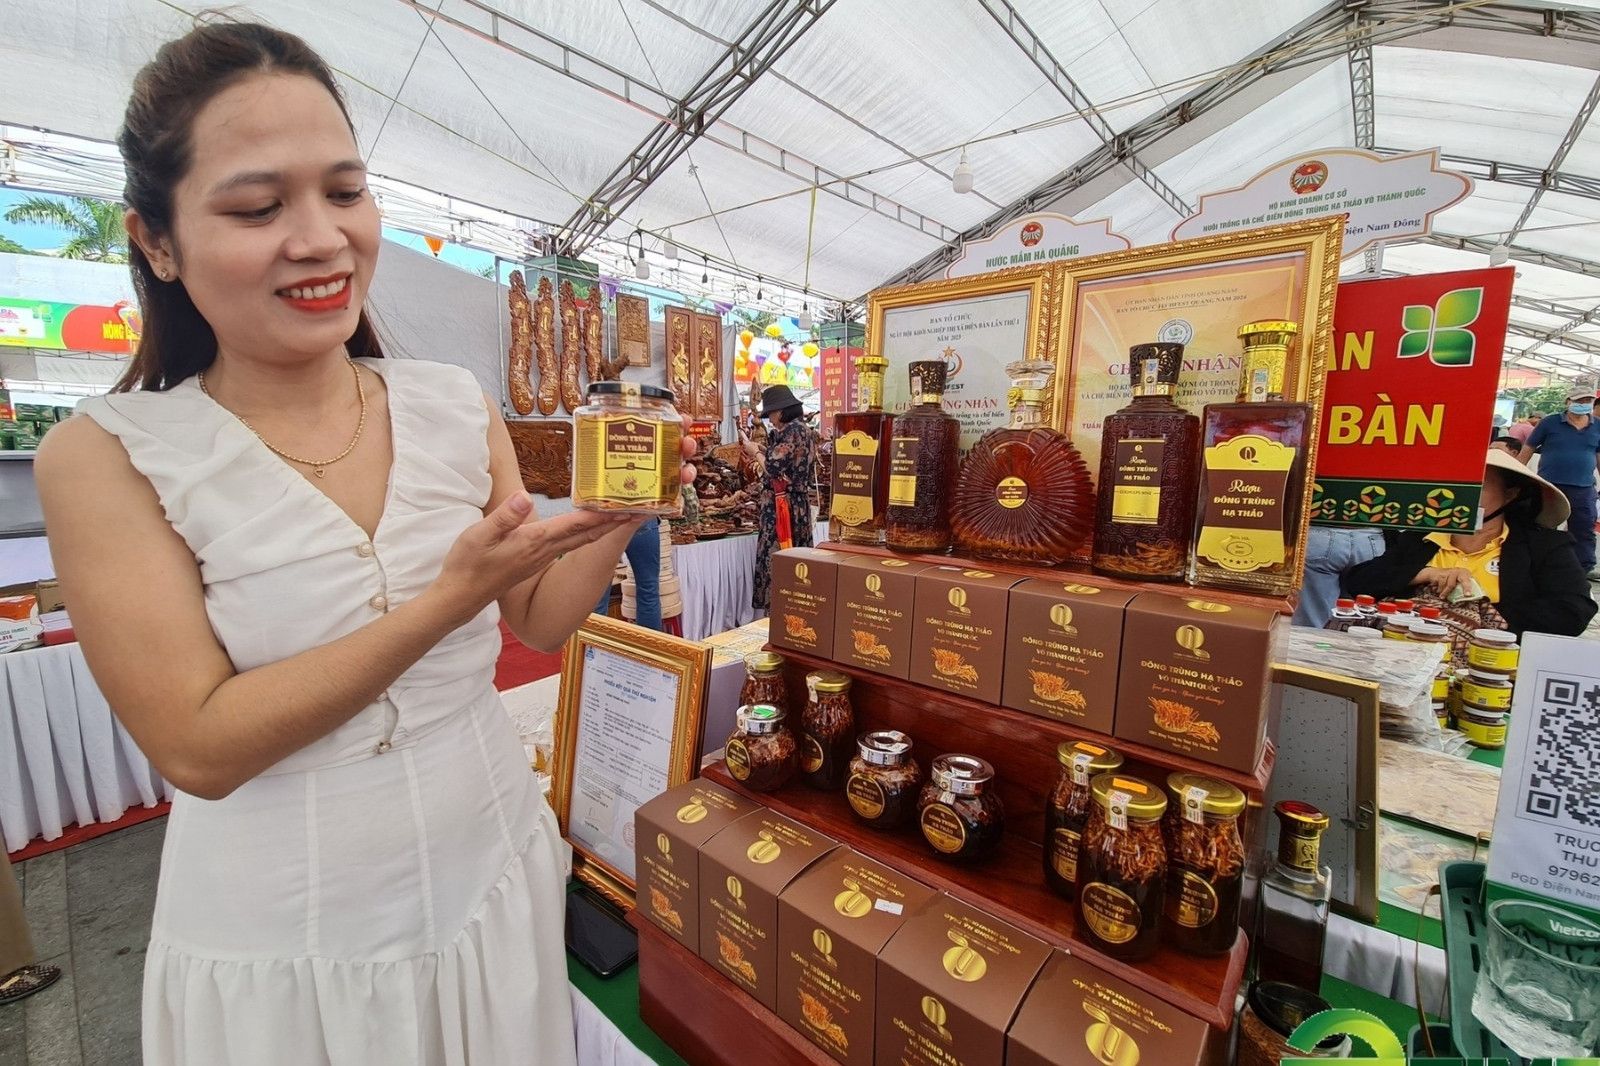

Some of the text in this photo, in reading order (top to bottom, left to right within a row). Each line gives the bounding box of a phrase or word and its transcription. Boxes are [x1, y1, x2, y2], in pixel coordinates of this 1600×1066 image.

[1203, 222, 1218, 232] NUÔI
[1220, 219, 1240, 229] TRỒNG
[1242, 217, 1250, 225] VÀ
[1252, 214, 1264, 223] CHẾ
[1266, 212, 1283, 222] BIẾN
[1306, 204, 1329, 215] TRÙNG
[1404, 188, 1426, 197] QUỐC
[1280, 200, 1297, 209] KINH
[1299, 195, 1323, 204] DOANH
[1367, 223, 1390, 232] Nam
[986, 255, 1008, 267] NƯỚC
[1034, 249, 1045, 260] HÀ
[1048, 244, 1079, 259] QUẢNG
[1328, 394, 1445, 445] BÀN
[1214, 496, 1275, 506] ĐÔNG TRÙNG
[1223, 508, 1263, 518] HẠ THẢO
[1141, 660, 1243, 687] ĐÔNG TRÙNG HẠ THẢO
[1511, 872, 1539, 885] PGD
[1543, 880, 1572, 894] Điện
